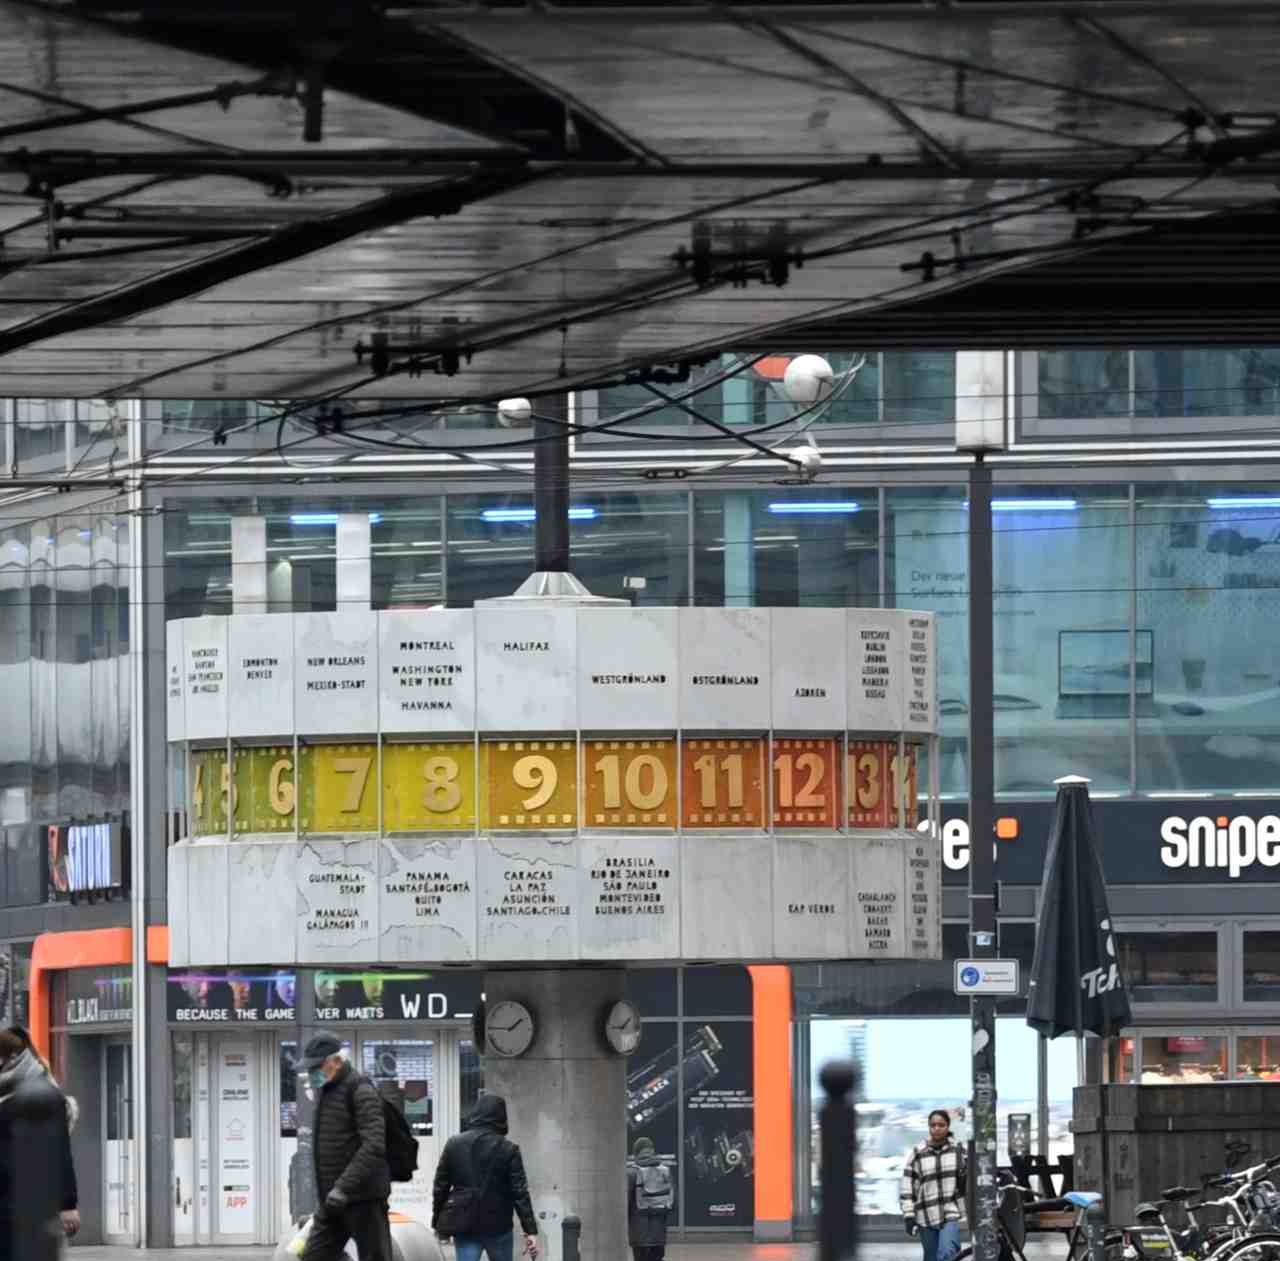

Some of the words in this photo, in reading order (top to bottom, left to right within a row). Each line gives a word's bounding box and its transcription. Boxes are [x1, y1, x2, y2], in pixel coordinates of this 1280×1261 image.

[400, 642, 455, 651] MONTREAL
[503, 641, 550, 651] HALIFAX
[392, 665, 463, 675] WASHINGTON
[400, 677, 423, 687] NEW
[401, 701, 453, 711] HAVANNA
[270, 758, 296, 816] 6
[335, 757, 374, 813] 7
[423, 755, 462, 813] 8
[512, 754, 558, 812] 9
[594, 753, 669, 810] 10
[692, 753, 744, 809] 11
[773, 752, 826, 808] 12
[847, 752, 881, 809] 13
[606, 857, 656, 868] BRASILIA
[406, 872, 449, 881] PANAMA
[504, 871, 553, 881] CARACAS
[415, 907, 440, 917] LIMA
[595, 906, 633, 916] BUENOS
[636, 905, 665, 915] AIRES
[176, 1008, 228, 1020] BECAUSE
[236, 1008, 258, 1020] THE
[265, 1008, 295, 1020] GAME
[346, 1007, 384, 1018] WAITS
